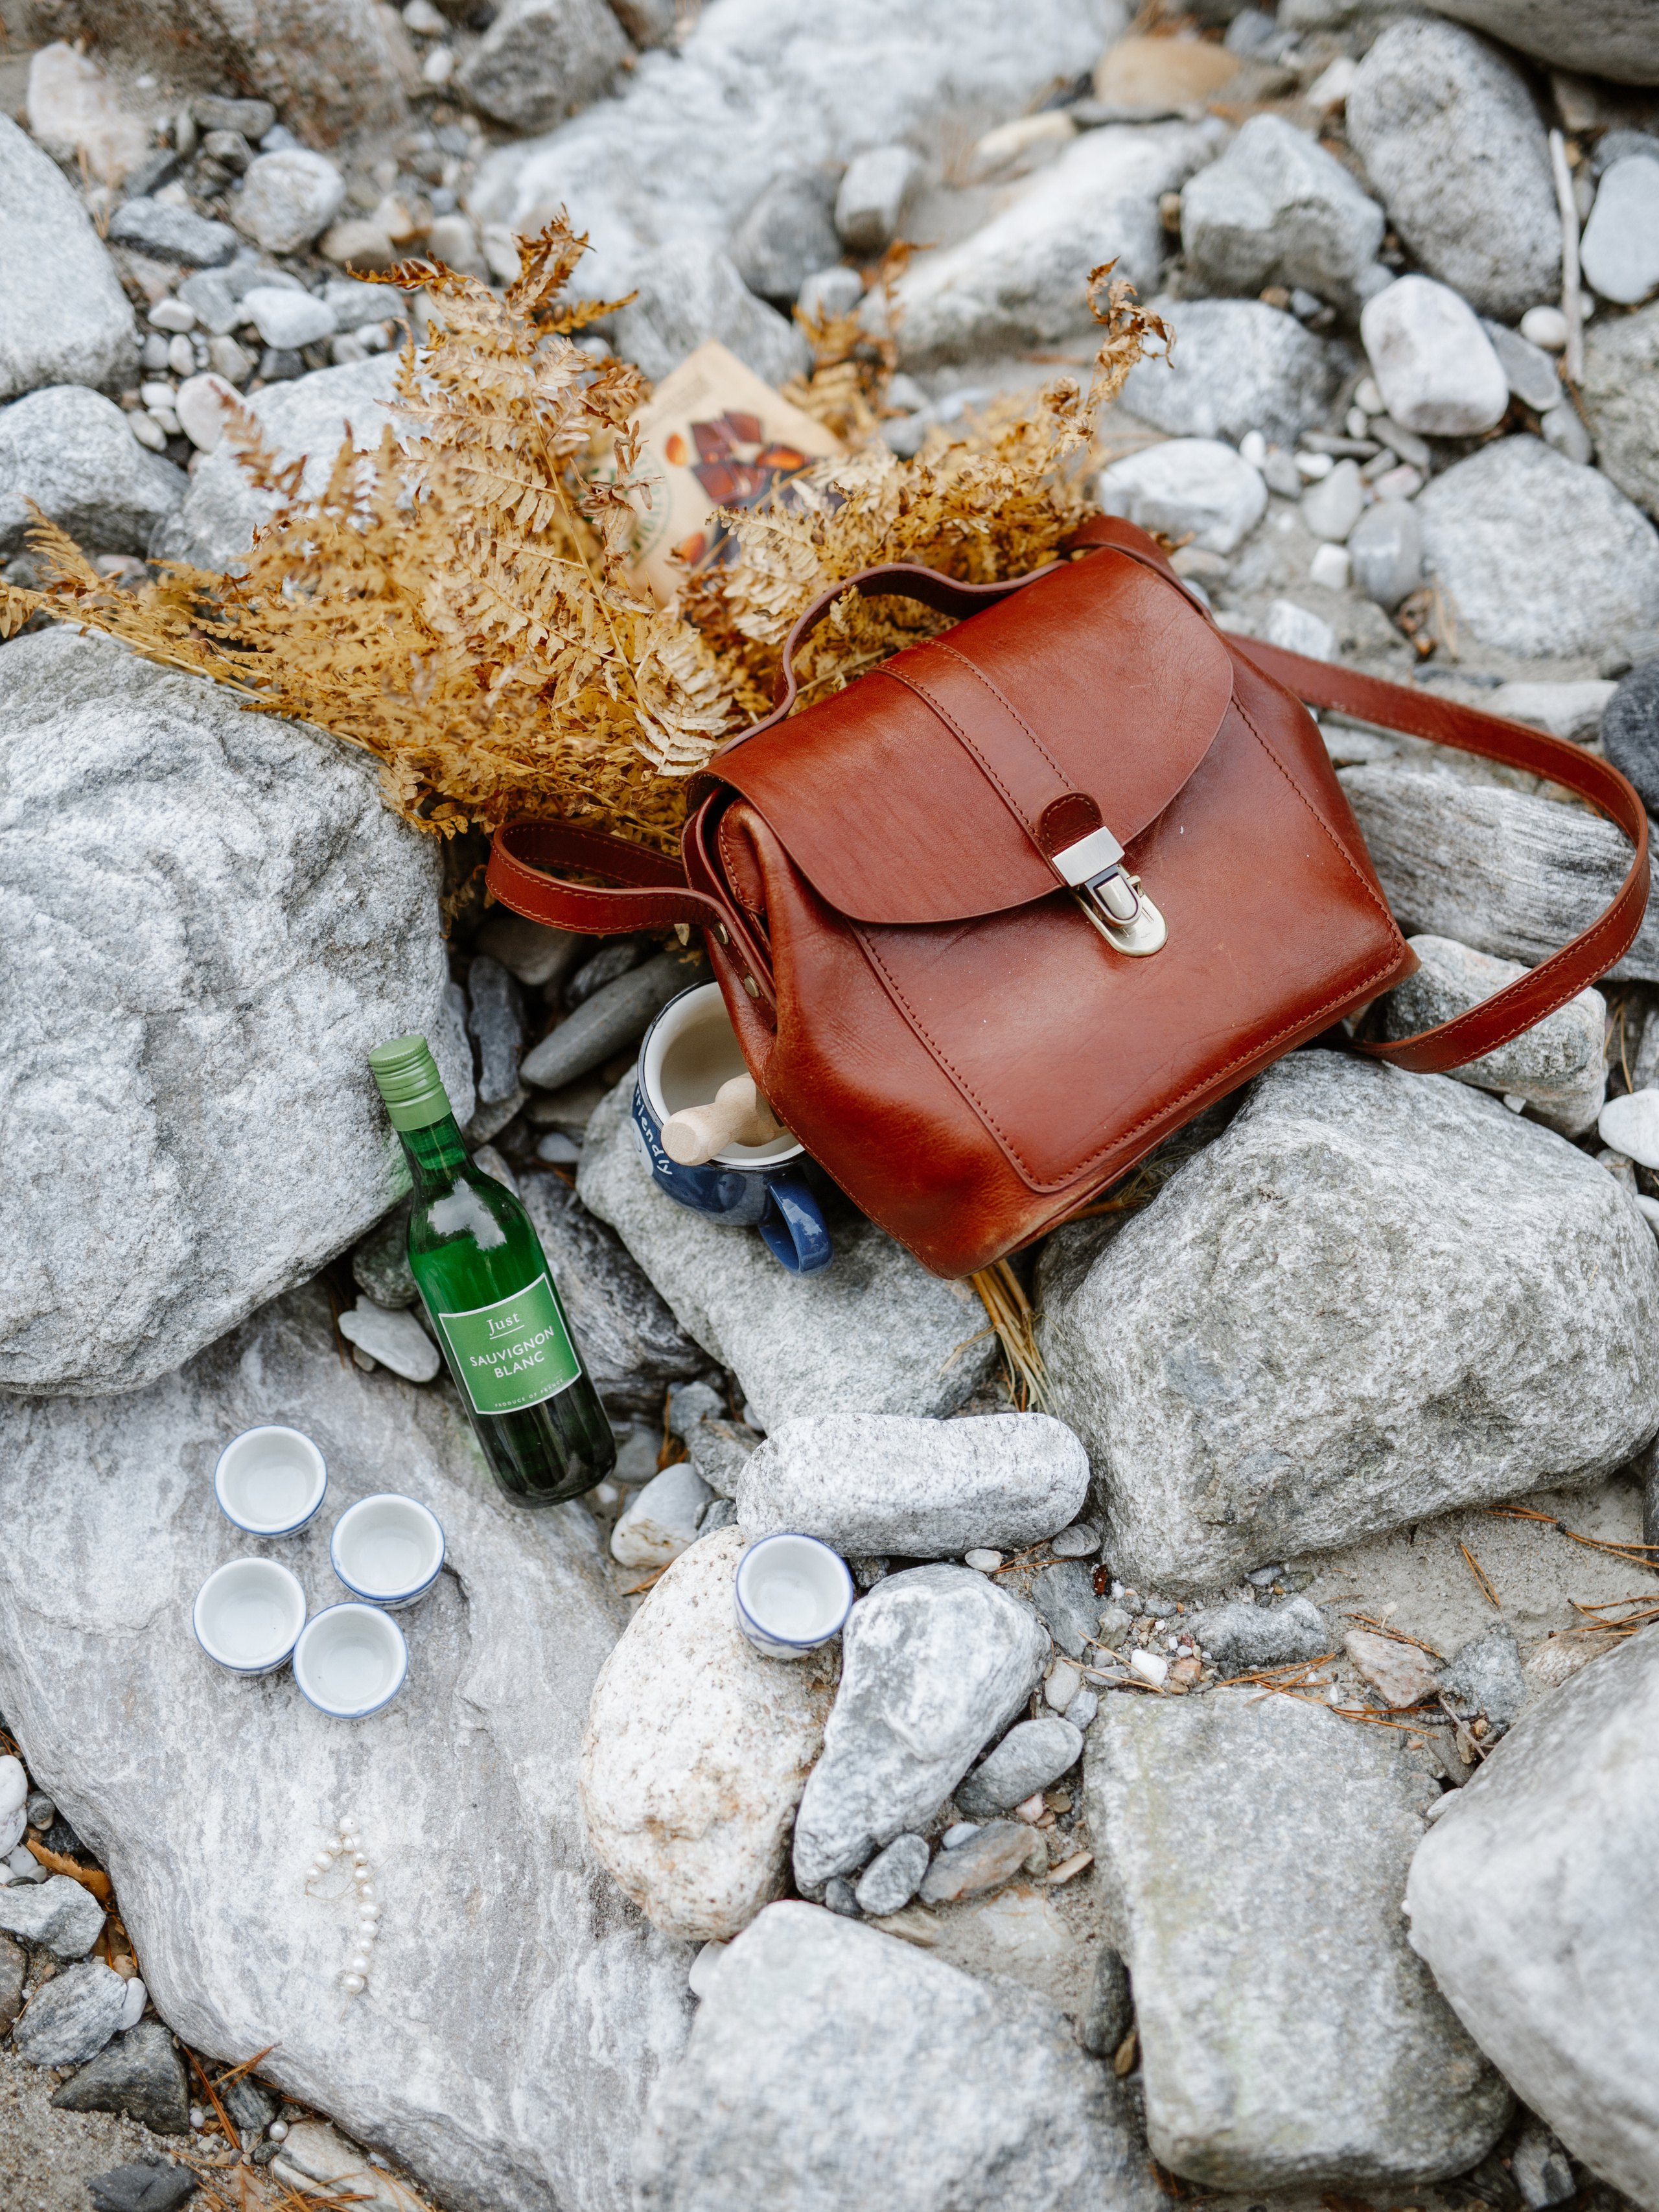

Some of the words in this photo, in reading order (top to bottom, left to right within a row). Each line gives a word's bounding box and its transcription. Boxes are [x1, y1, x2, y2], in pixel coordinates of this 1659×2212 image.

[486, 1312, 520, 1336] Just
[469, 1325, 555, 1367] SAUVIGNON
[494, 1351, 545, 1379] BLANC
[494, 1397, 526, 1408] PRODUCE
[540, 1379, 563, 1394] FRANCE
